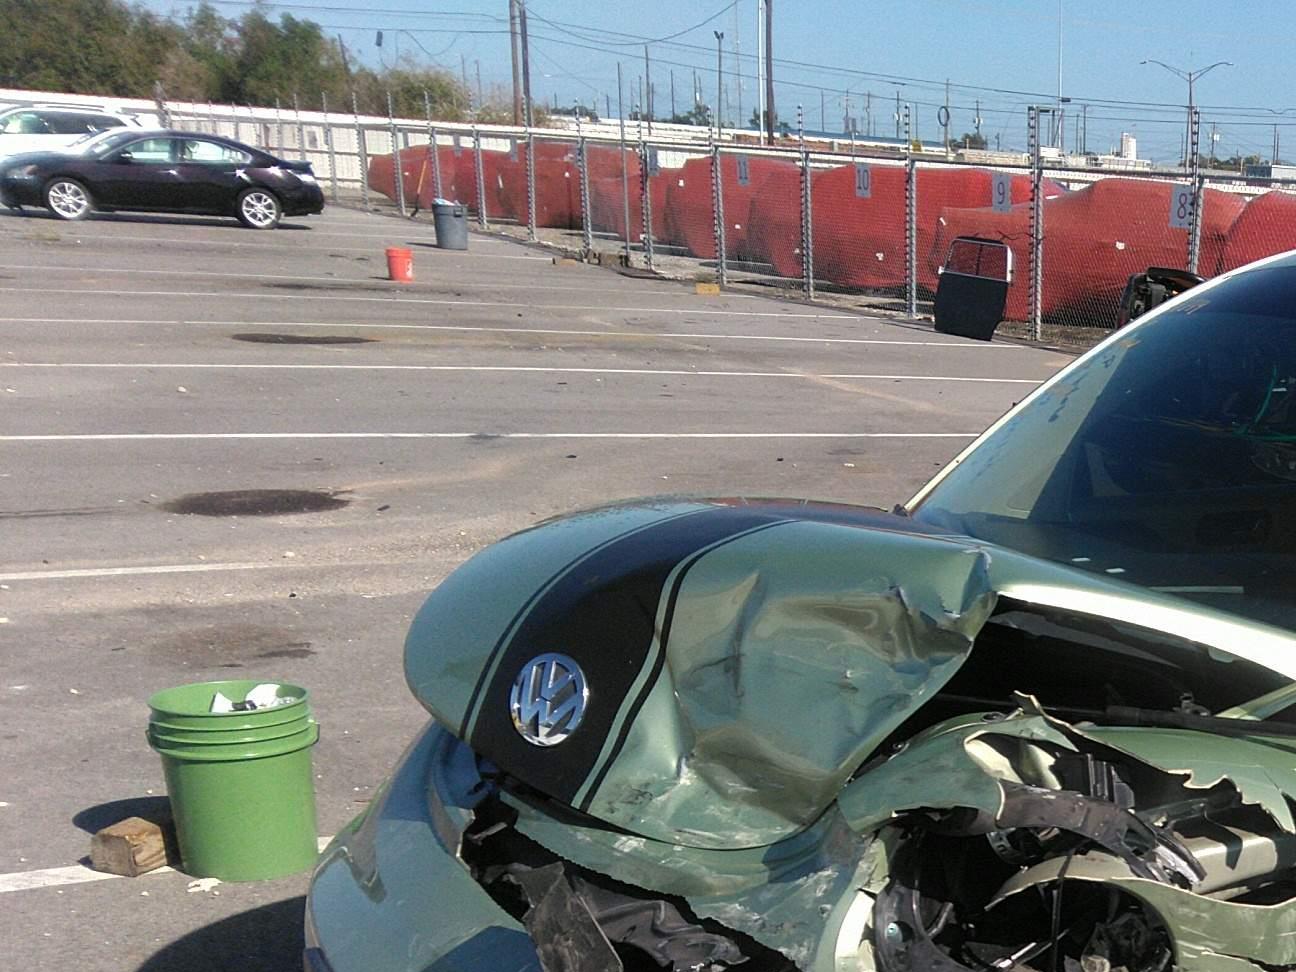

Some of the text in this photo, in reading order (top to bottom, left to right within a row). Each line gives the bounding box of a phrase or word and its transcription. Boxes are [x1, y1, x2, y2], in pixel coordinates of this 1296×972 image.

[737, 159, 748, 180] 11
[857, 168, 870, 191] 10
[997, 181, 1006, 205] 9
[1176, 192, 1188, 220] 8
[513, 656, 583, 742] VW
